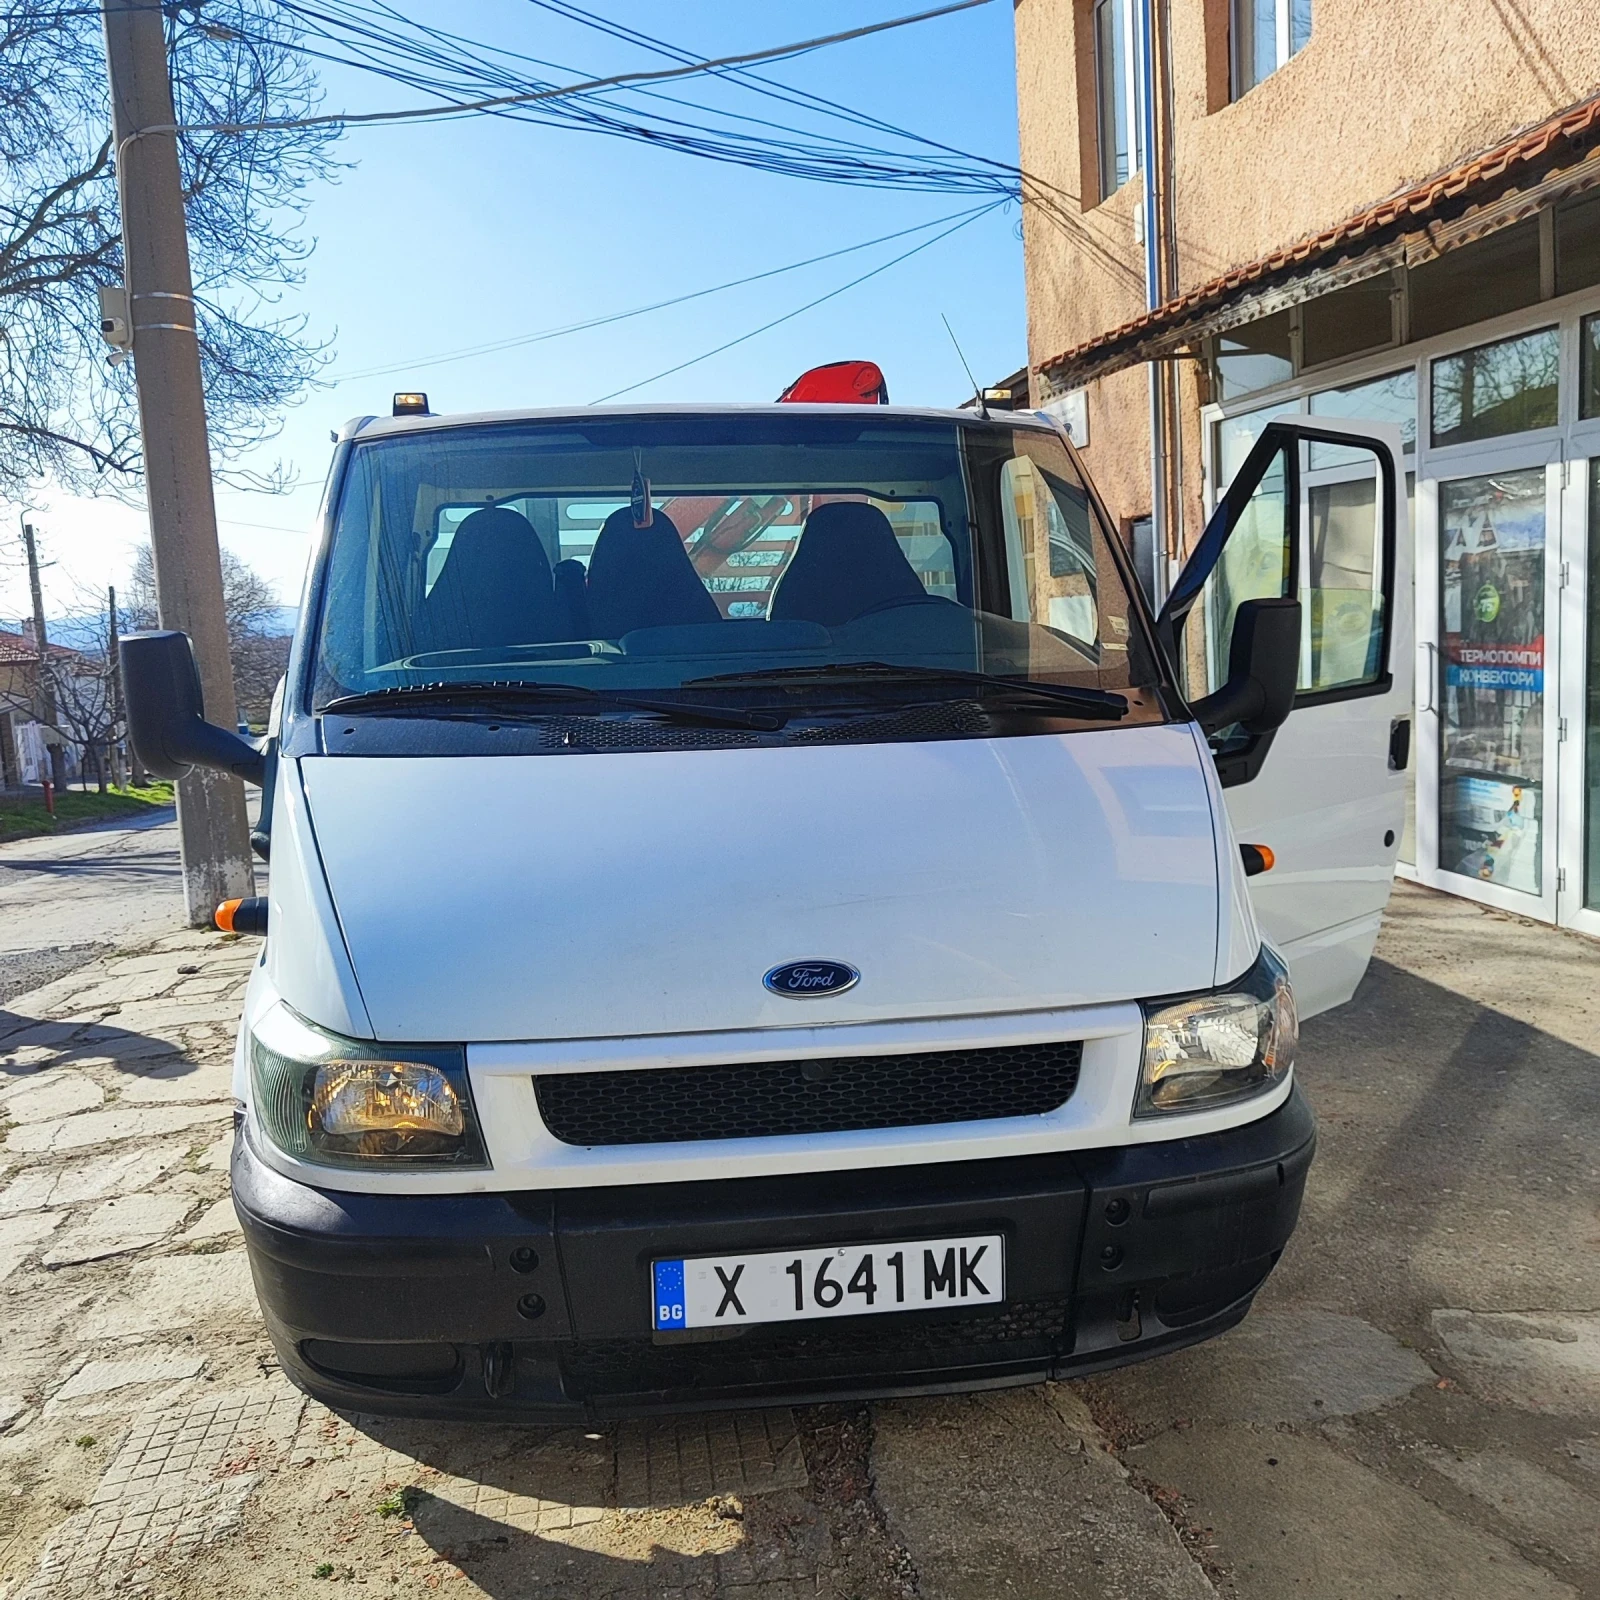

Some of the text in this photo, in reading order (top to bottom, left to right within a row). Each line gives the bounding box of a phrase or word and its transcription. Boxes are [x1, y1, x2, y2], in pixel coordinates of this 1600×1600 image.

[1459, 649, 1541, 666] ТЕРМОПОМПИ
[1460, 669, 1534, 686] КОНВЕКТОРИ
[788, 967, 835, 988] Ford
[713, 1244, 991, 1318] X 1641 MK
[659, 1304, 683, 1321] BG
